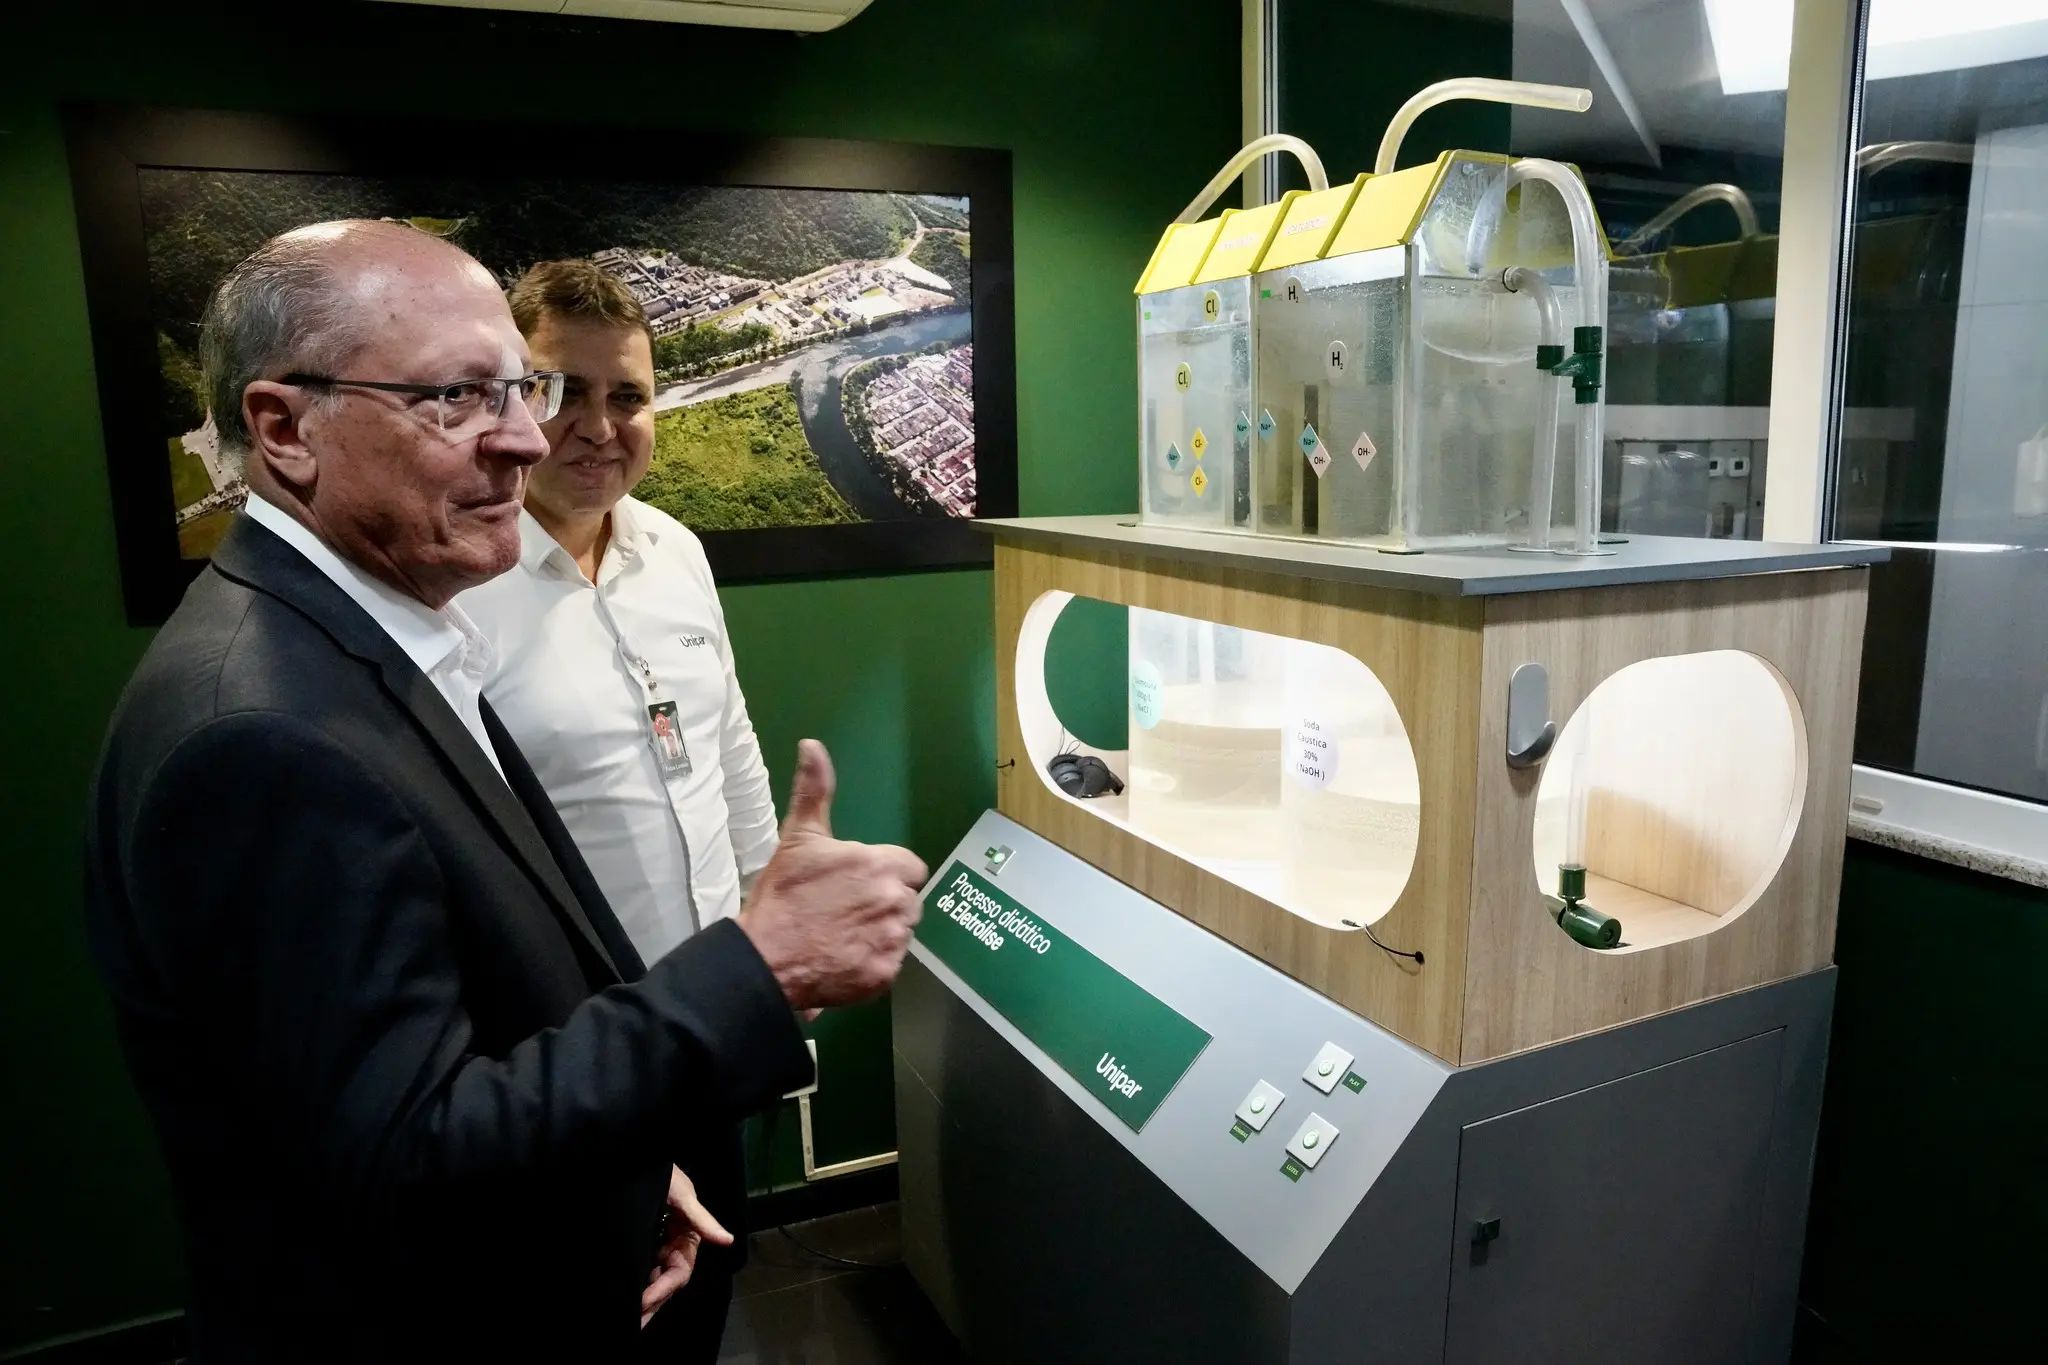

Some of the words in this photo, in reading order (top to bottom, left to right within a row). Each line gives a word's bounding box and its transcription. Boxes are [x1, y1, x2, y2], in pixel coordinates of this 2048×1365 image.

[679, 634, 706, 648] Unipar
[1303, 718, 1320, 731] Soda
[936, 892, 953, 913] de
[949, 900, 1005, 951] Eletrólise
[950, 872, 1000, 919] Processo
[998, 905, 1051, 955] didático
[1096, 1052, 1143, 1100] Unipar
[1286, 1163, 1299, 1176] LUZES
